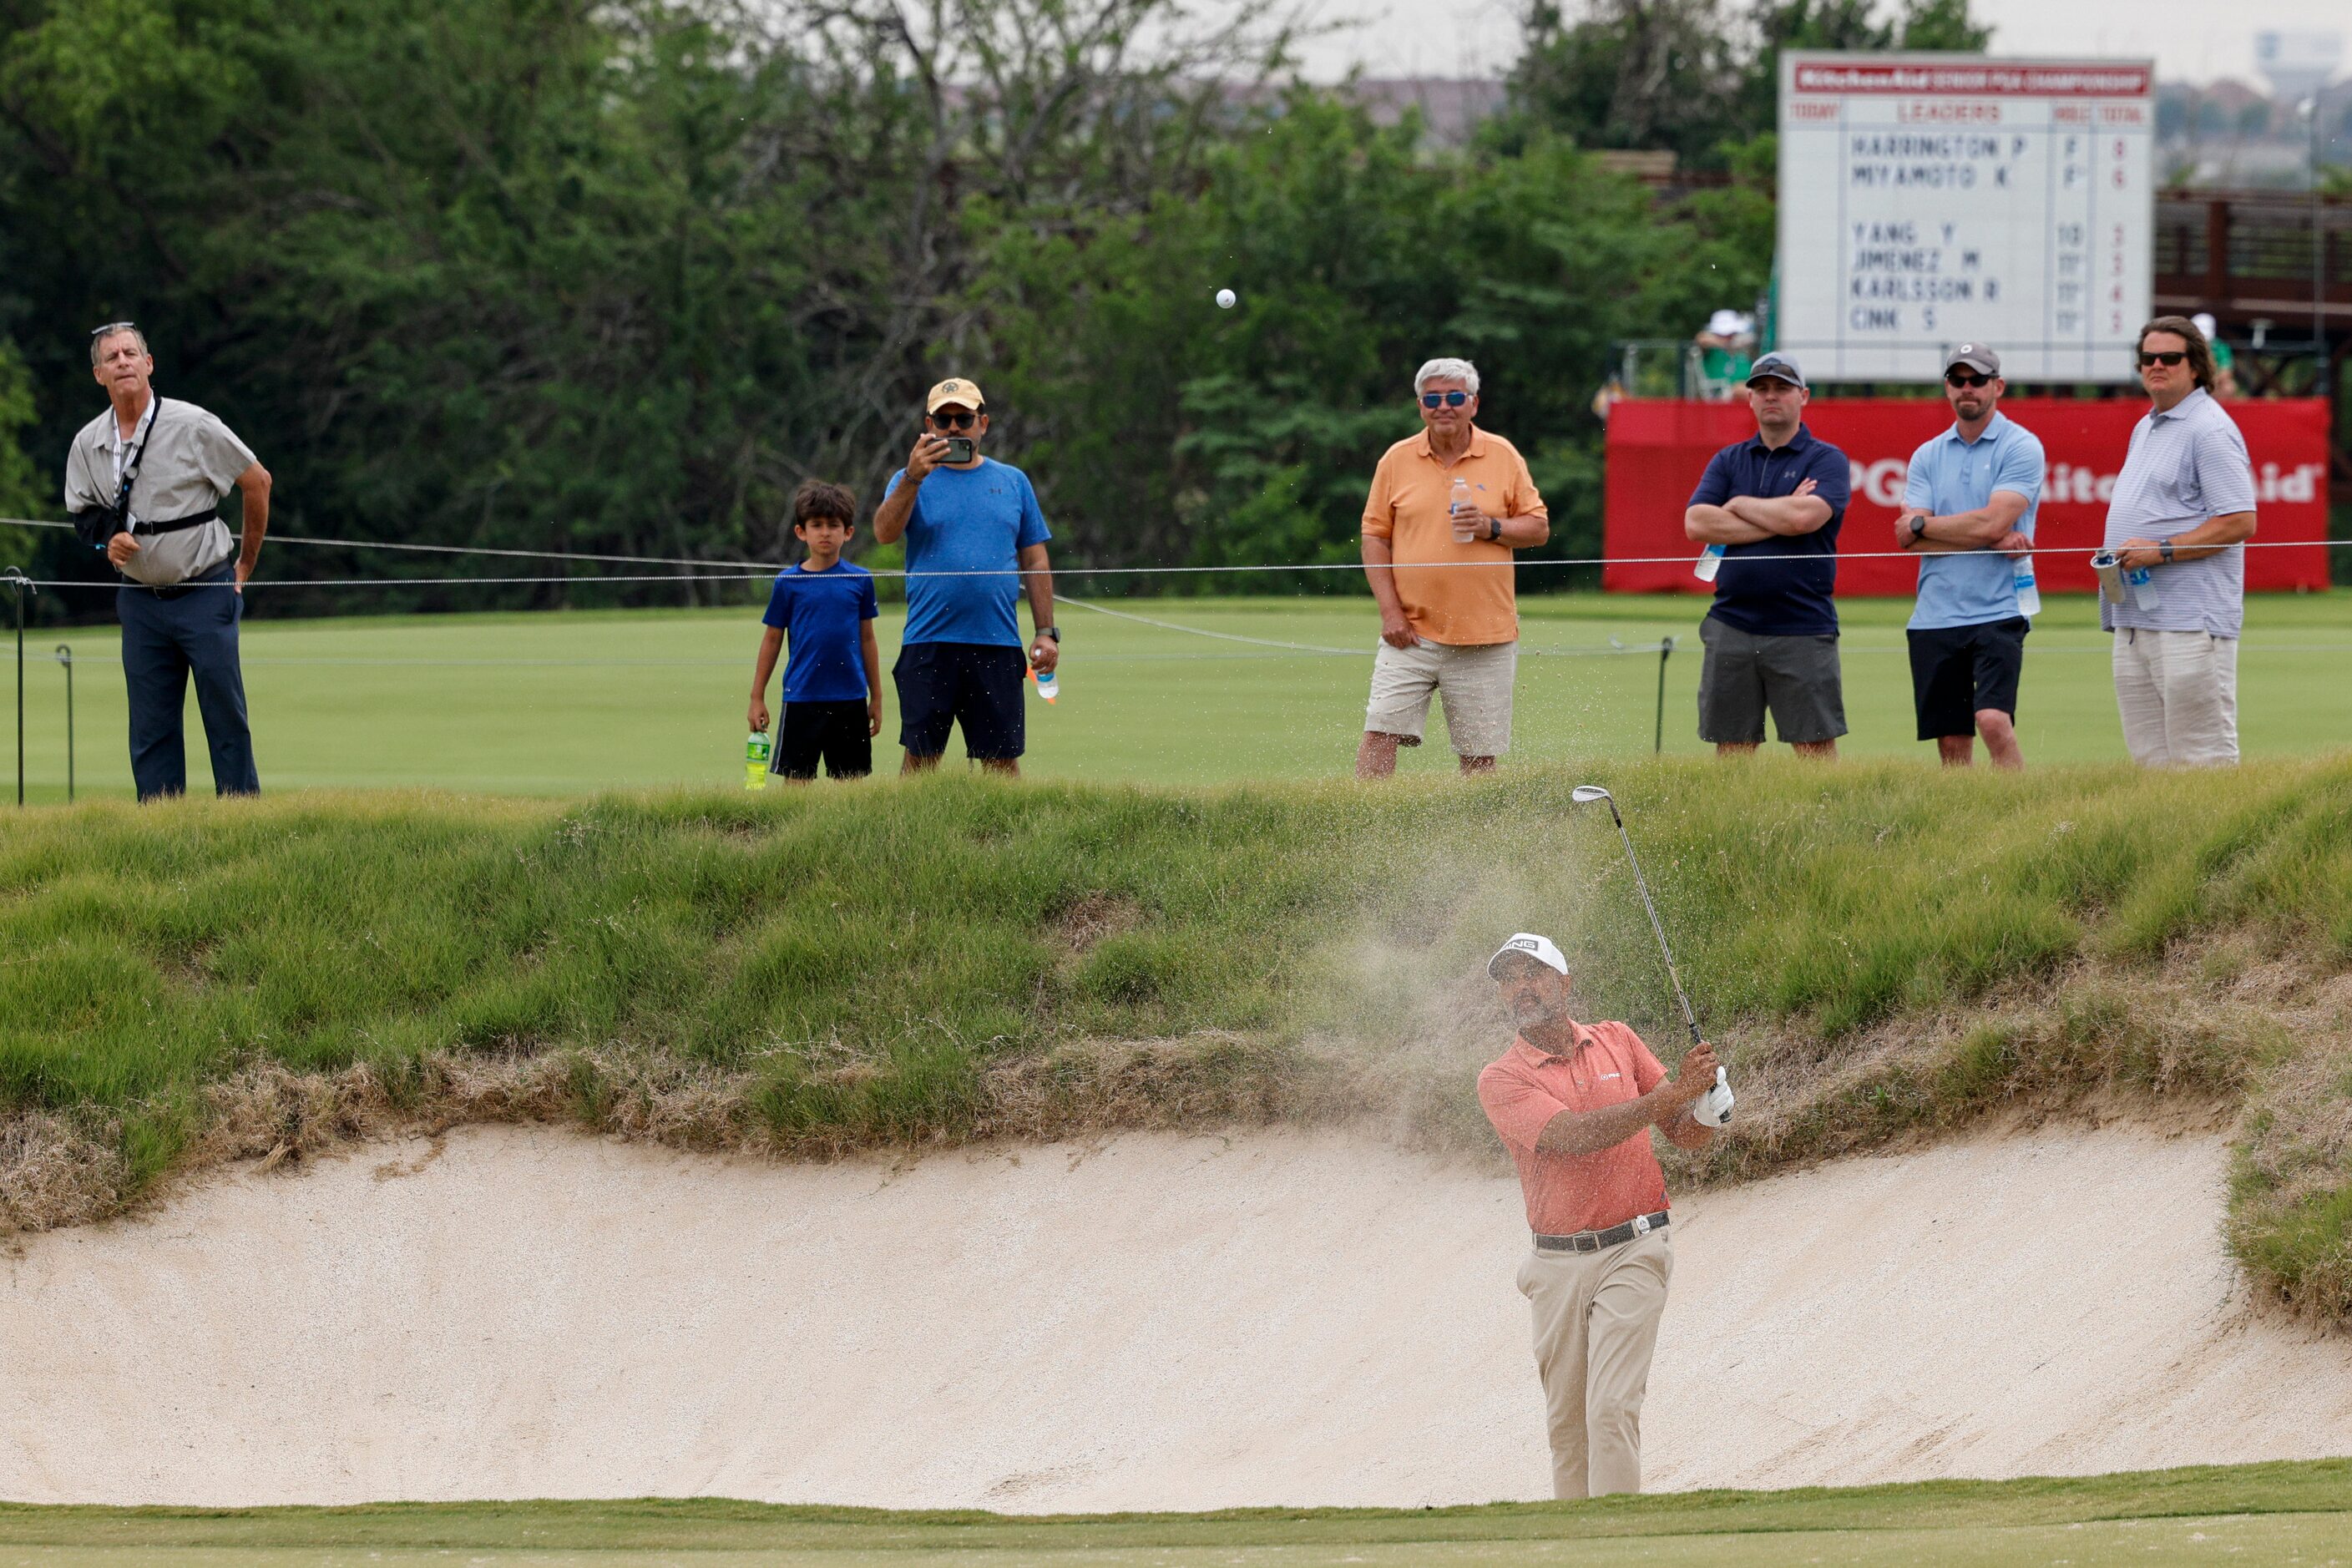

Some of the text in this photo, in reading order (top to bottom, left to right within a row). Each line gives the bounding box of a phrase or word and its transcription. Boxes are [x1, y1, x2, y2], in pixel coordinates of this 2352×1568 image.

[1899, 102, 2001, 123] LEADERS
[1852, 137, 1997, 157] HARRINGTON
[2012, 137, 2026, 157] P
[1852, 165, 1976, 187] MIYAMOTO
[1995, 165, 2011, 187] K
[1853, 223, 1916, 244] YANG
[1942, 223, 1955, 243] Y
[1852, 250, 1941, 271] JIMENEZ
[1963, 250, 1980, 271] M
[1851, 279, 1971, 301] KARLSSON
[1850, 307, 1902, 329] CINK
[1923, 308, 1936, 329] S
[1505, 940, 1536, 949] ING
